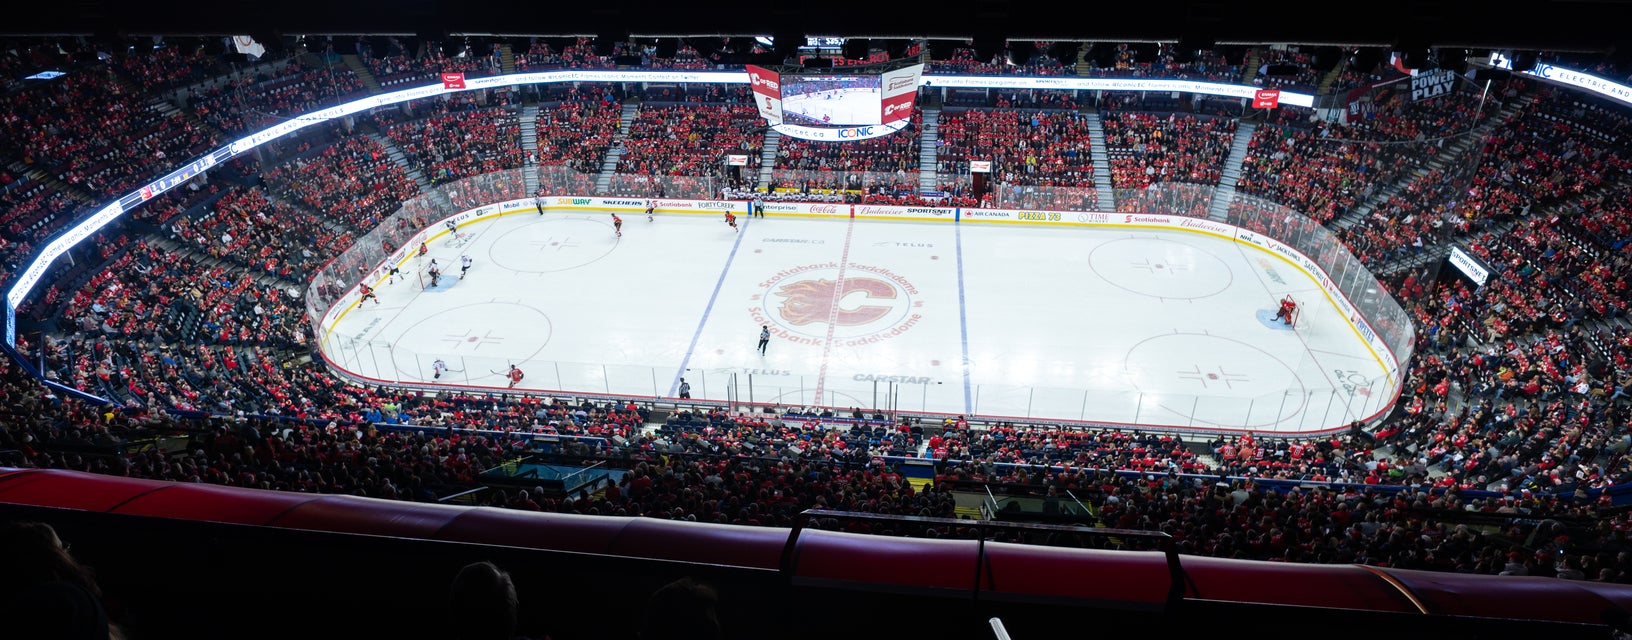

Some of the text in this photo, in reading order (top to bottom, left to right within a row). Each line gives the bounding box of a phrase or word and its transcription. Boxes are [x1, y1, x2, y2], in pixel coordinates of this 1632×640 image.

[1411, 70, 1455, 90] POWER
[1412, 81, 1455, 100] PLAY
[837, 126, 874, 139] ICONIC
[503, 202, 521, 210] Mobil
[557, 198, 592, 206] SUBWAY
[860, 206, 903, 215] Budweiser
[907, 207, 952, 215] SPORTSNET
[1018, 211, 1062, 221] PIZZA 73
[1134, 216, 1170, 224] Scotiabank
[1179, 218, 1228, 233] Budweiser
[1452, 251, 1486, 282] SPORTSNET
[758, 261, 919, 295] Scotiabank Saddledome
[834, 313, 922, 348] Saddledome
[743, 367, 791, 377] TELUS
